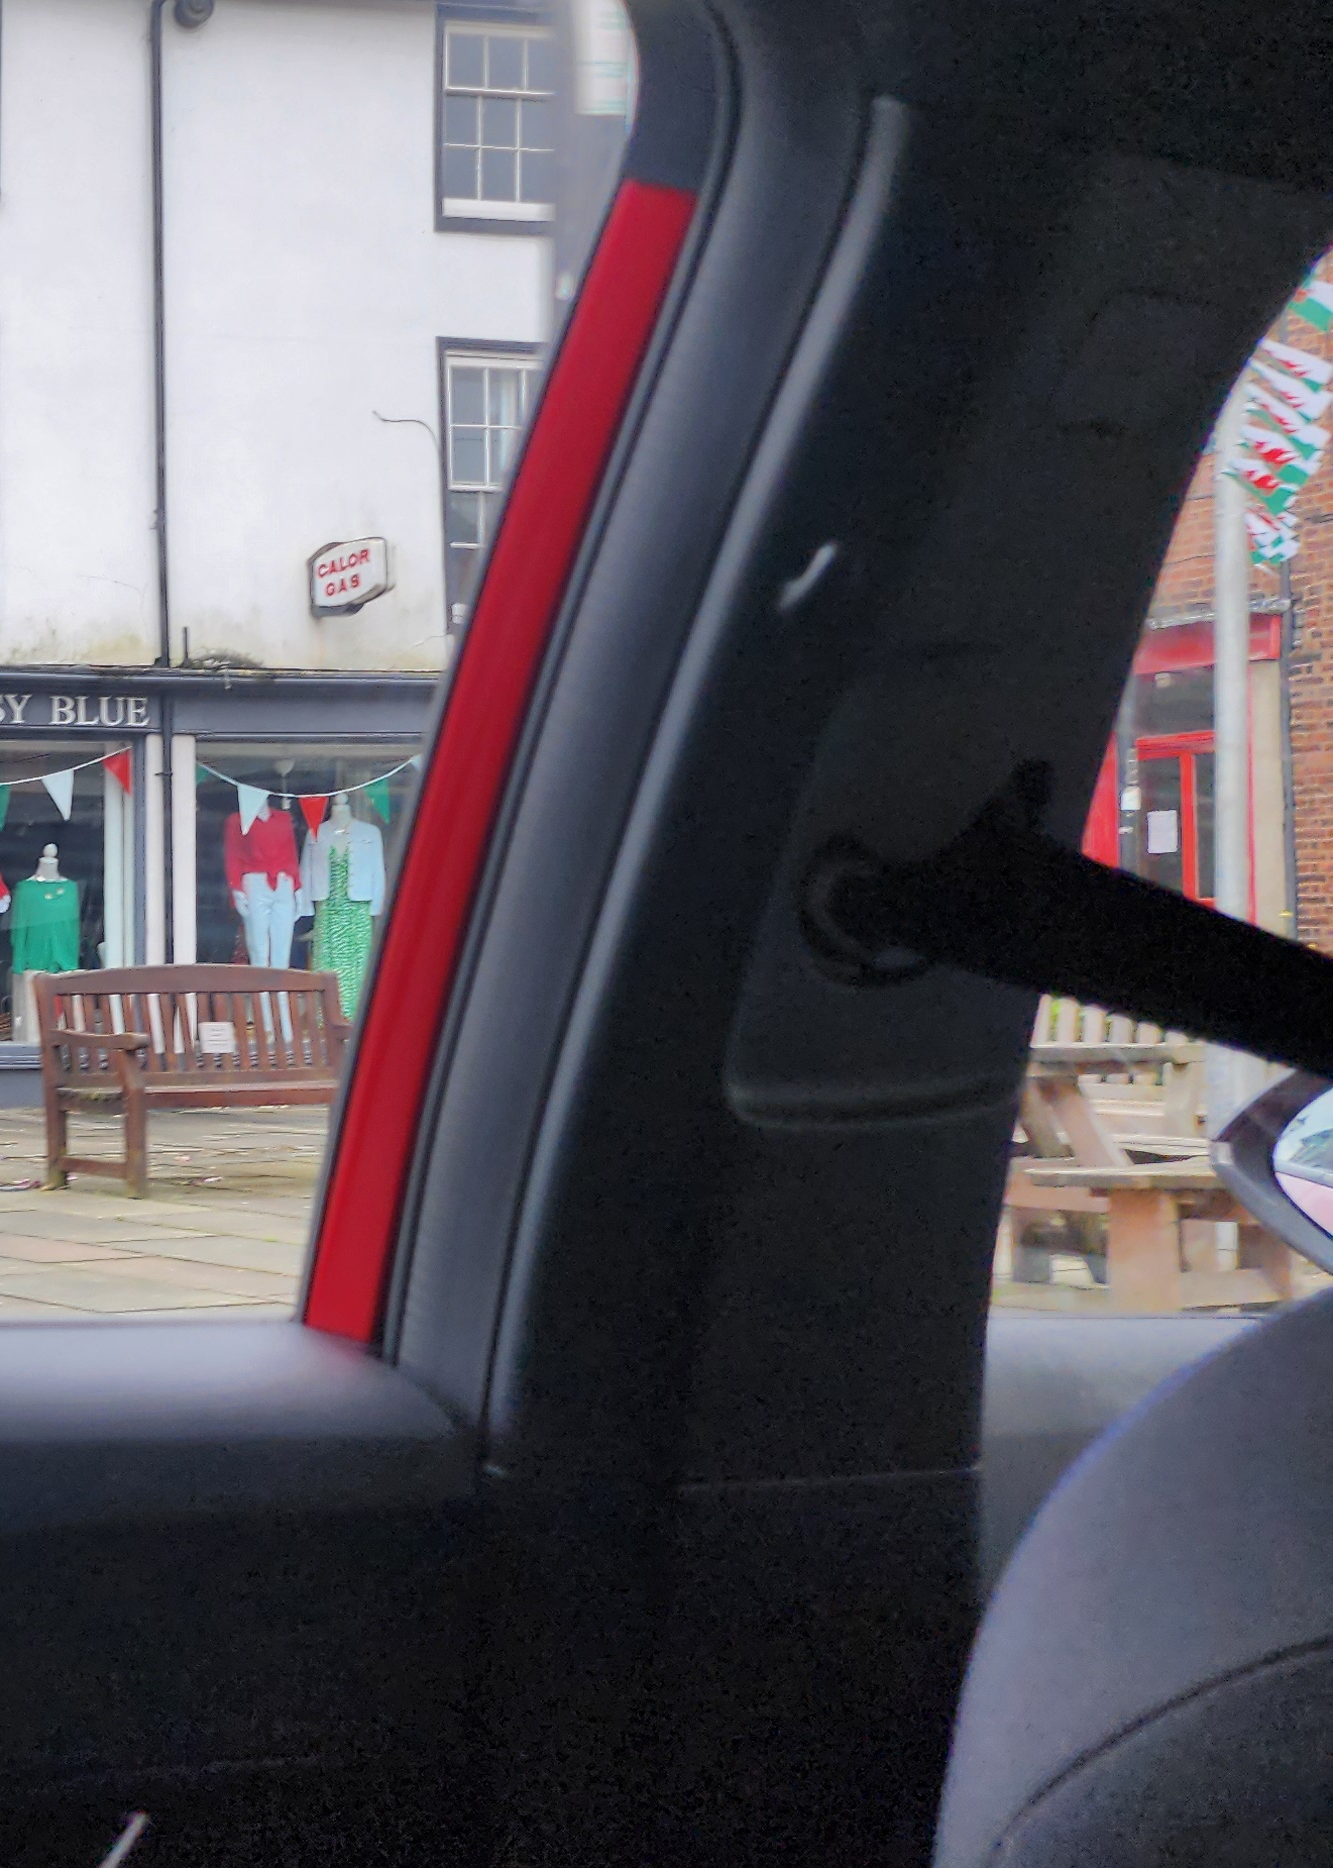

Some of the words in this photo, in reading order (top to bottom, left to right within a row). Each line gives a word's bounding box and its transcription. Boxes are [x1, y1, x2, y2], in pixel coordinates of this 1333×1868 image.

[317, 548, 370, 578] CALOR
[324, 573, 361, 597] GAS
[48, 695, 150, 727] BLUE
